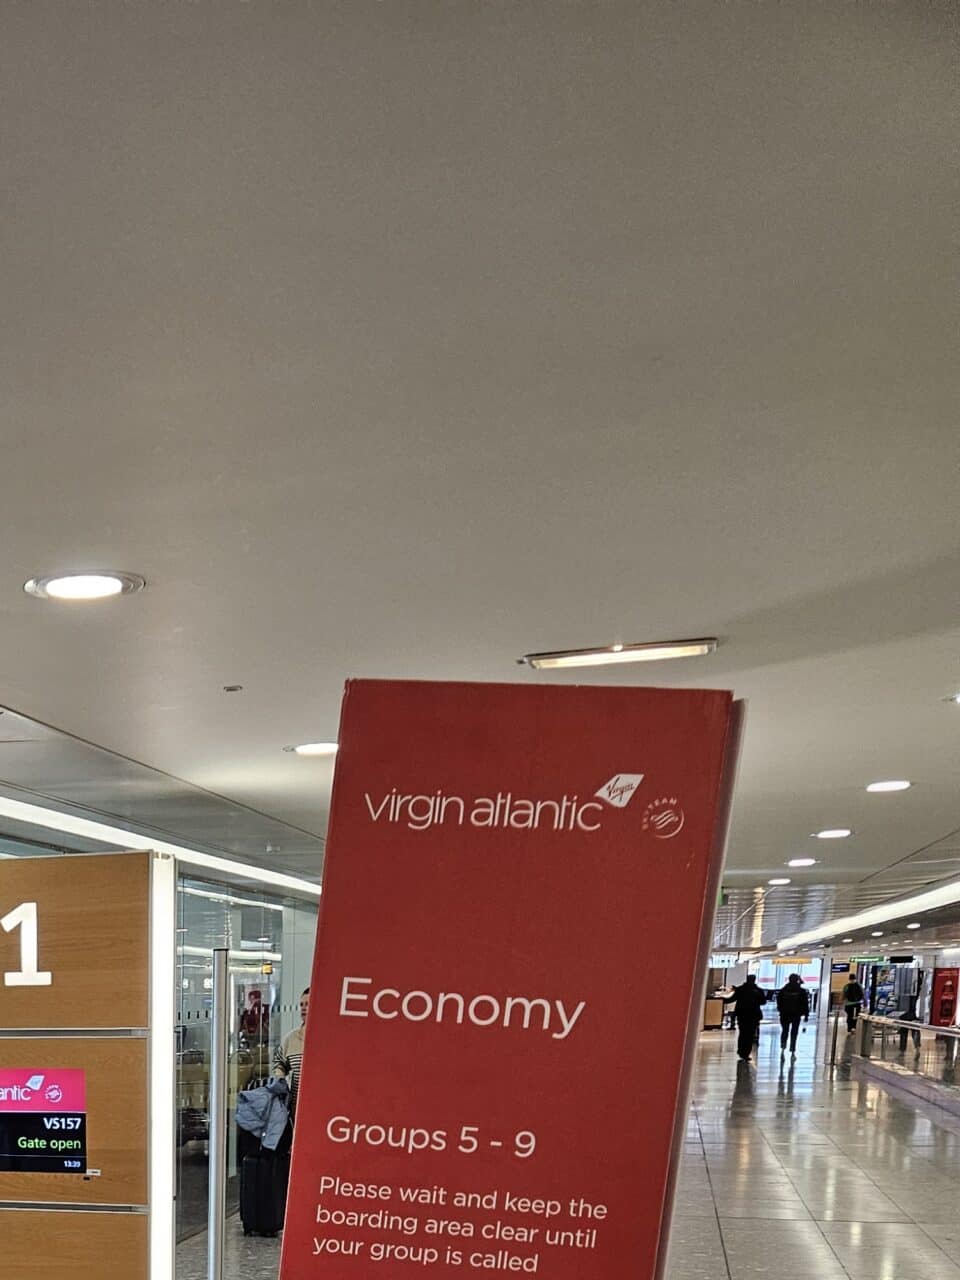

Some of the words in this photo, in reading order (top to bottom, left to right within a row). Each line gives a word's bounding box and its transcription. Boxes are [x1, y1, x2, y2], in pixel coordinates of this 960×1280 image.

[365, 788, 465, 830] virgin
[470, 791, 603, 831] atlantic
[339, 976, 586, 1039] Economy
[17, 1136, 47, 1149] Gate
[50, 1139, 82, 1151] open
[43, 1117, 82, 1129] VS157
[326, 1115, 447, 1153] Groups
[457, 1126, 479, 1153] 5
[514, 1131, 537, 1158] 9
[319, 1176, 392, 1200] Please
[399, 1186, 447, 1206] wait
[453, 1191, 497, 1210] and
[504, 1192, 561, 1219] keep
[569, 1198, 608, 1220] the
[316, 1205, 418, 1235] boarding
[424, 1218, 474, 1237] area
[481, 1221, 539, 1243] clear
[545, 1229, 597, 1249] until
[312, 1237, 363, 1256] your
[369, 1242, 438, 1265] group
[445, 1246, 462, 1265] is
[469, 1251, 539, 1272] called
